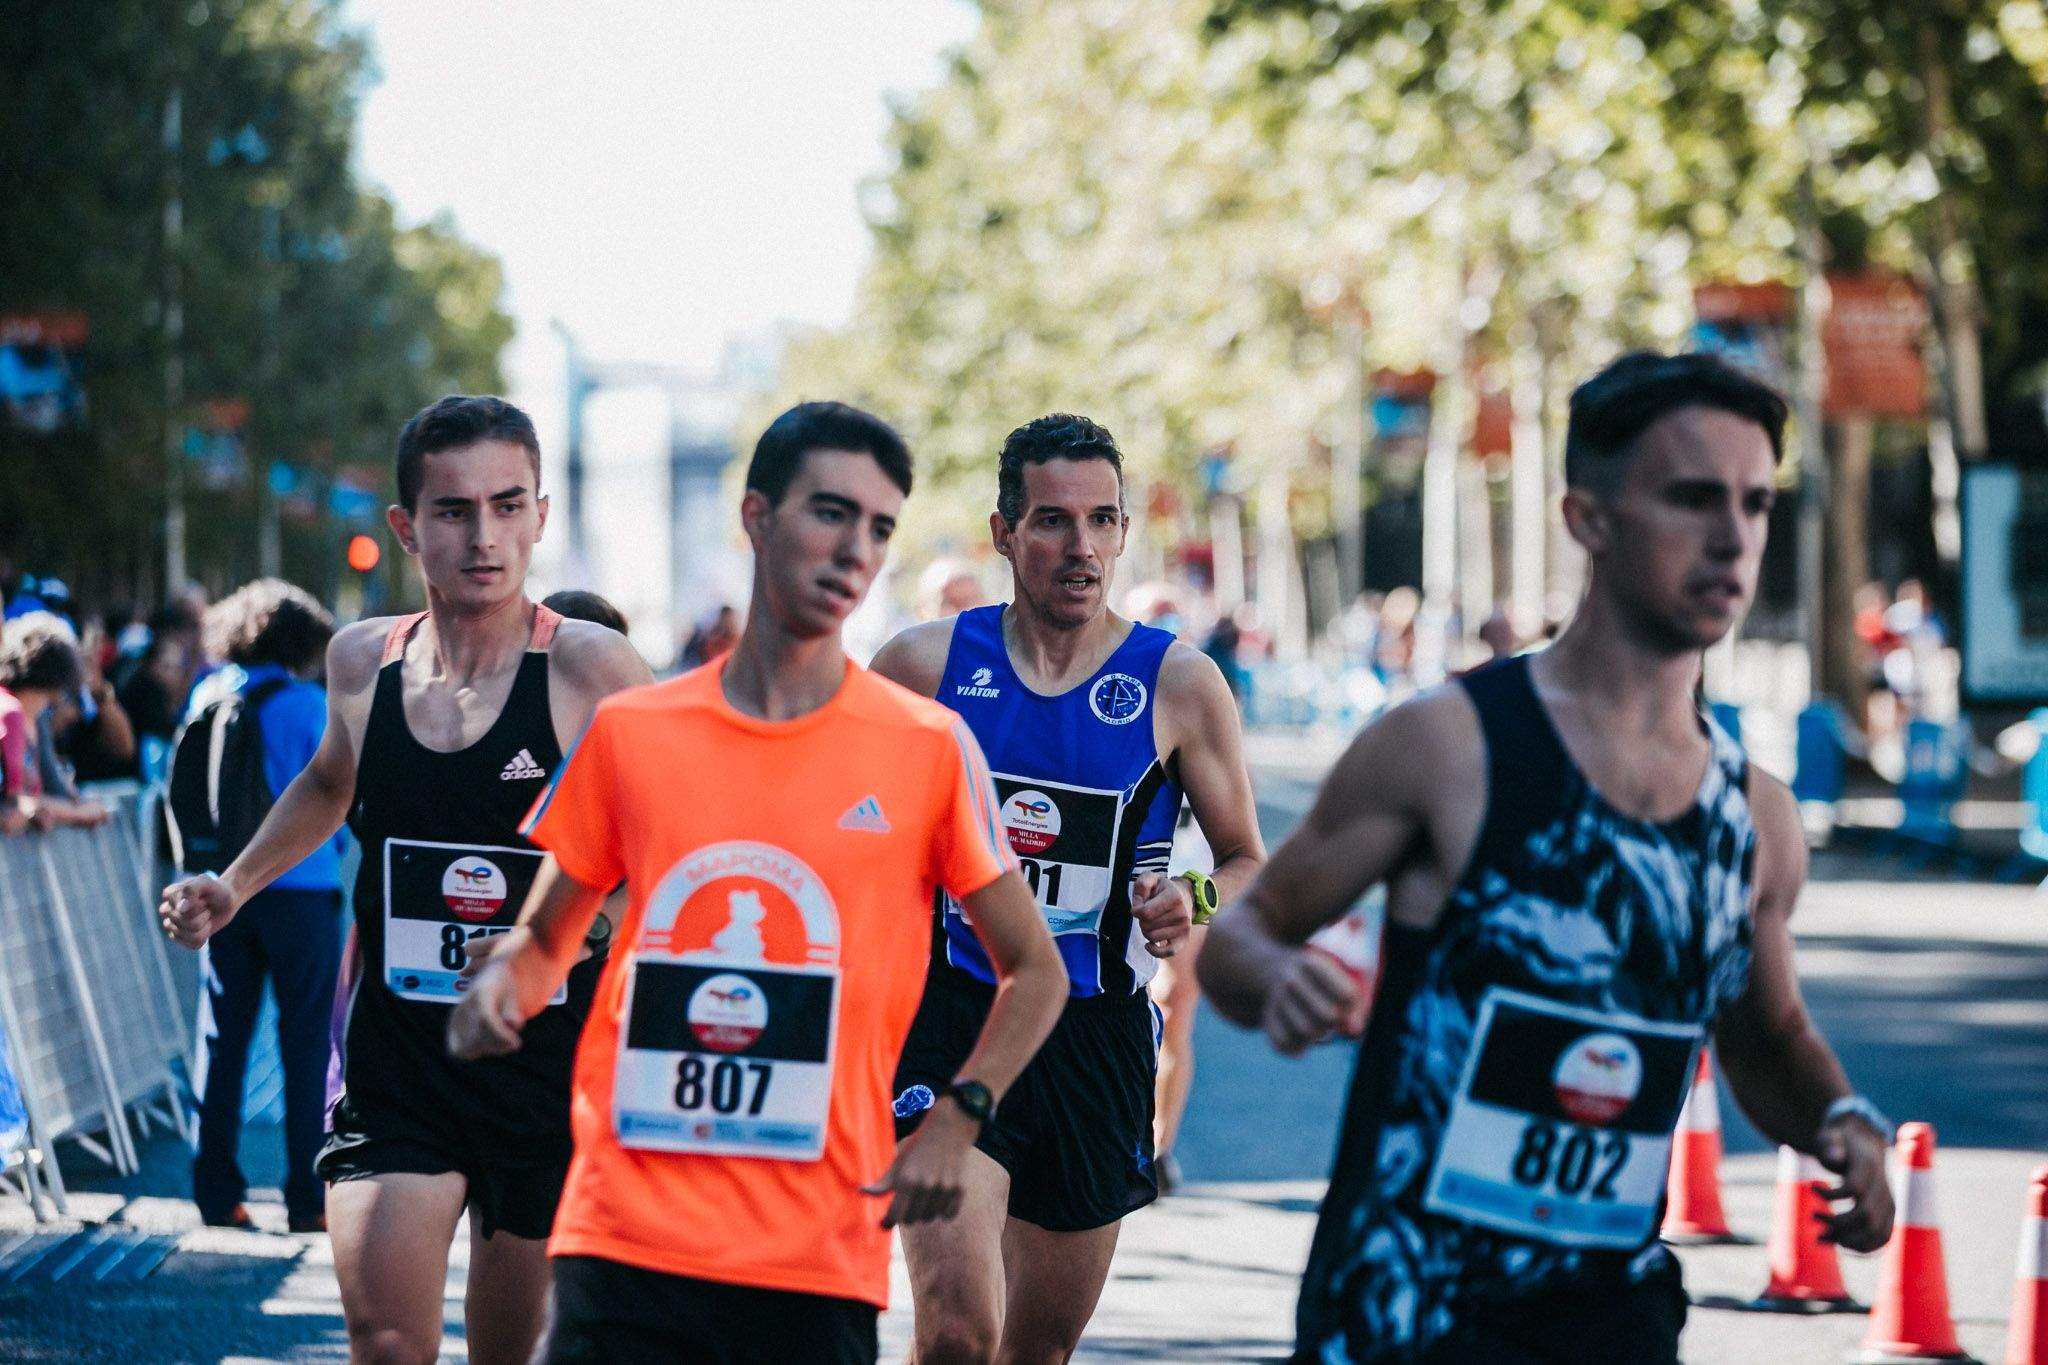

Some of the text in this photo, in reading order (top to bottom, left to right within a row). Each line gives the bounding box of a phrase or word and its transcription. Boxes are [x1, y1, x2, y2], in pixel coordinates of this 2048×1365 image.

[1120, 674, 1142, 687] PARIS
[957, 685, 1000, 698] VIATOR
[1099, 714, 1132, 725] MADRID
[500, 768, 546, 781] adidas
[1012, 817, 1048, 829] TotalEnergies
[1018, 829, 1040, 839] MILLA
[1009, 835, 1047, 847] DE MADRID
[1018, 858, 1063, 907] 01
[674, 1057, 773, 1116] 807
[1512, 1123, 1630, 1201] 802
